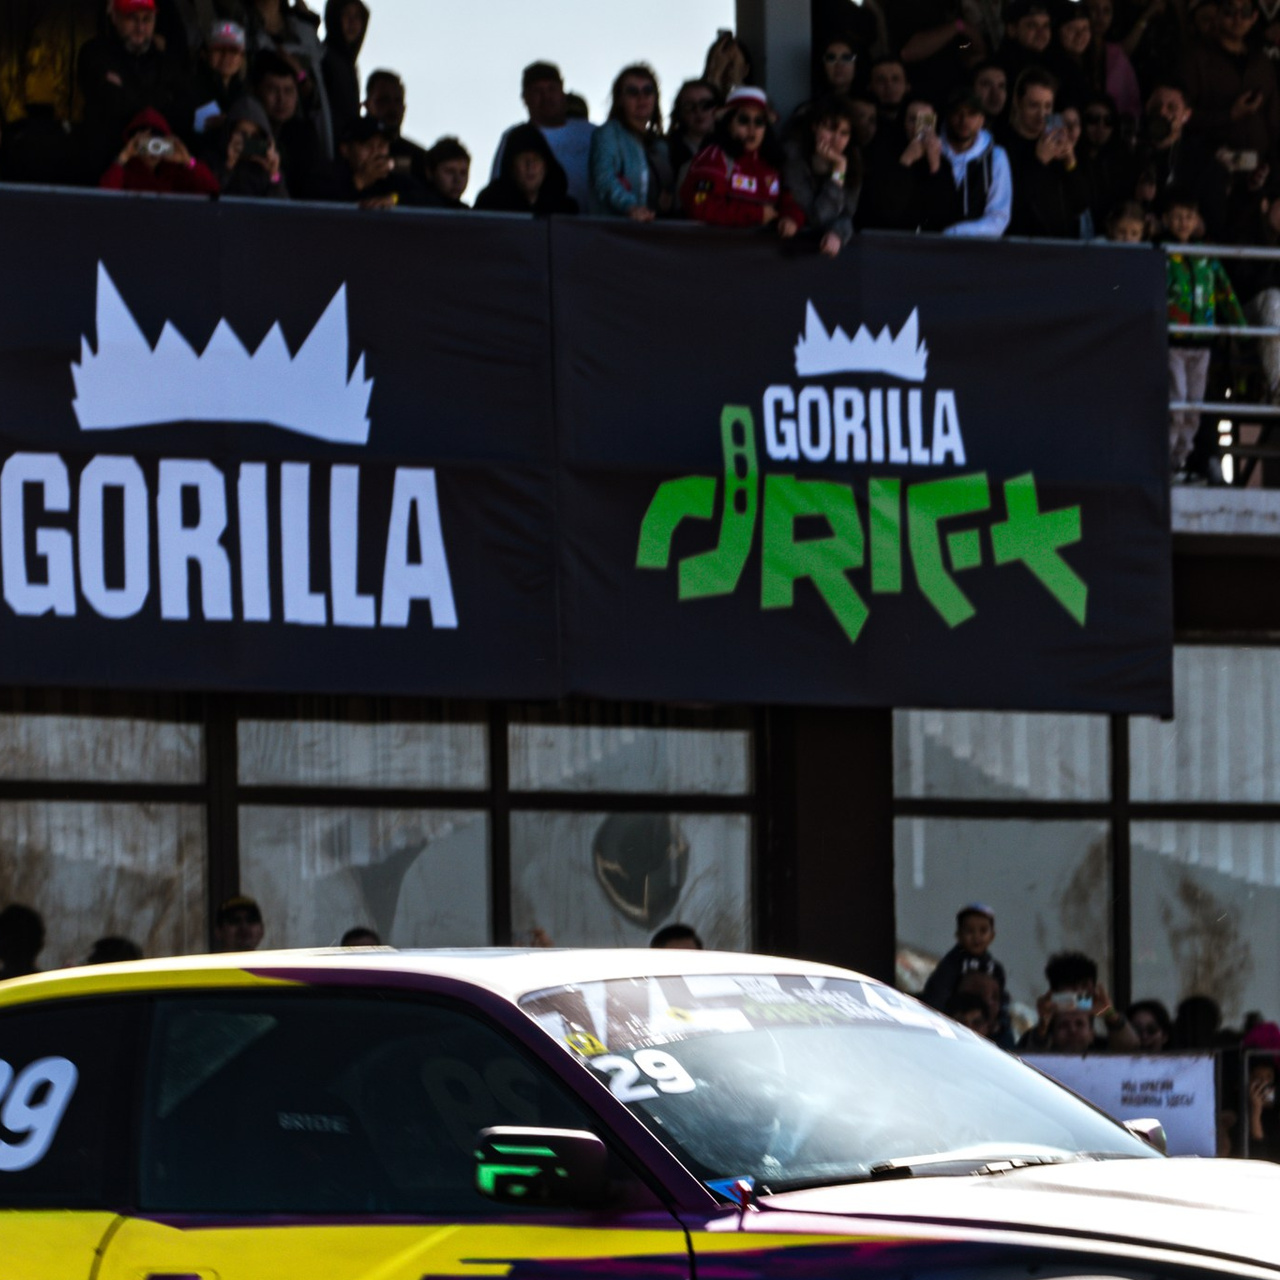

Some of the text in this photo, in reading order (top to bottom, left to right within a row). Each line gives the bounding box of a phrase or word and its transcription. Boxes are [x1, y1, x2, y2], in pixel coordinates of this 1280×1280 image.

[763, 384, 966, 465] GORILLA
[0, 451, 459, 629] GORILLA
[0, 1056, 79, 1171] 9
[589, 1049, 697, 1102] 29
